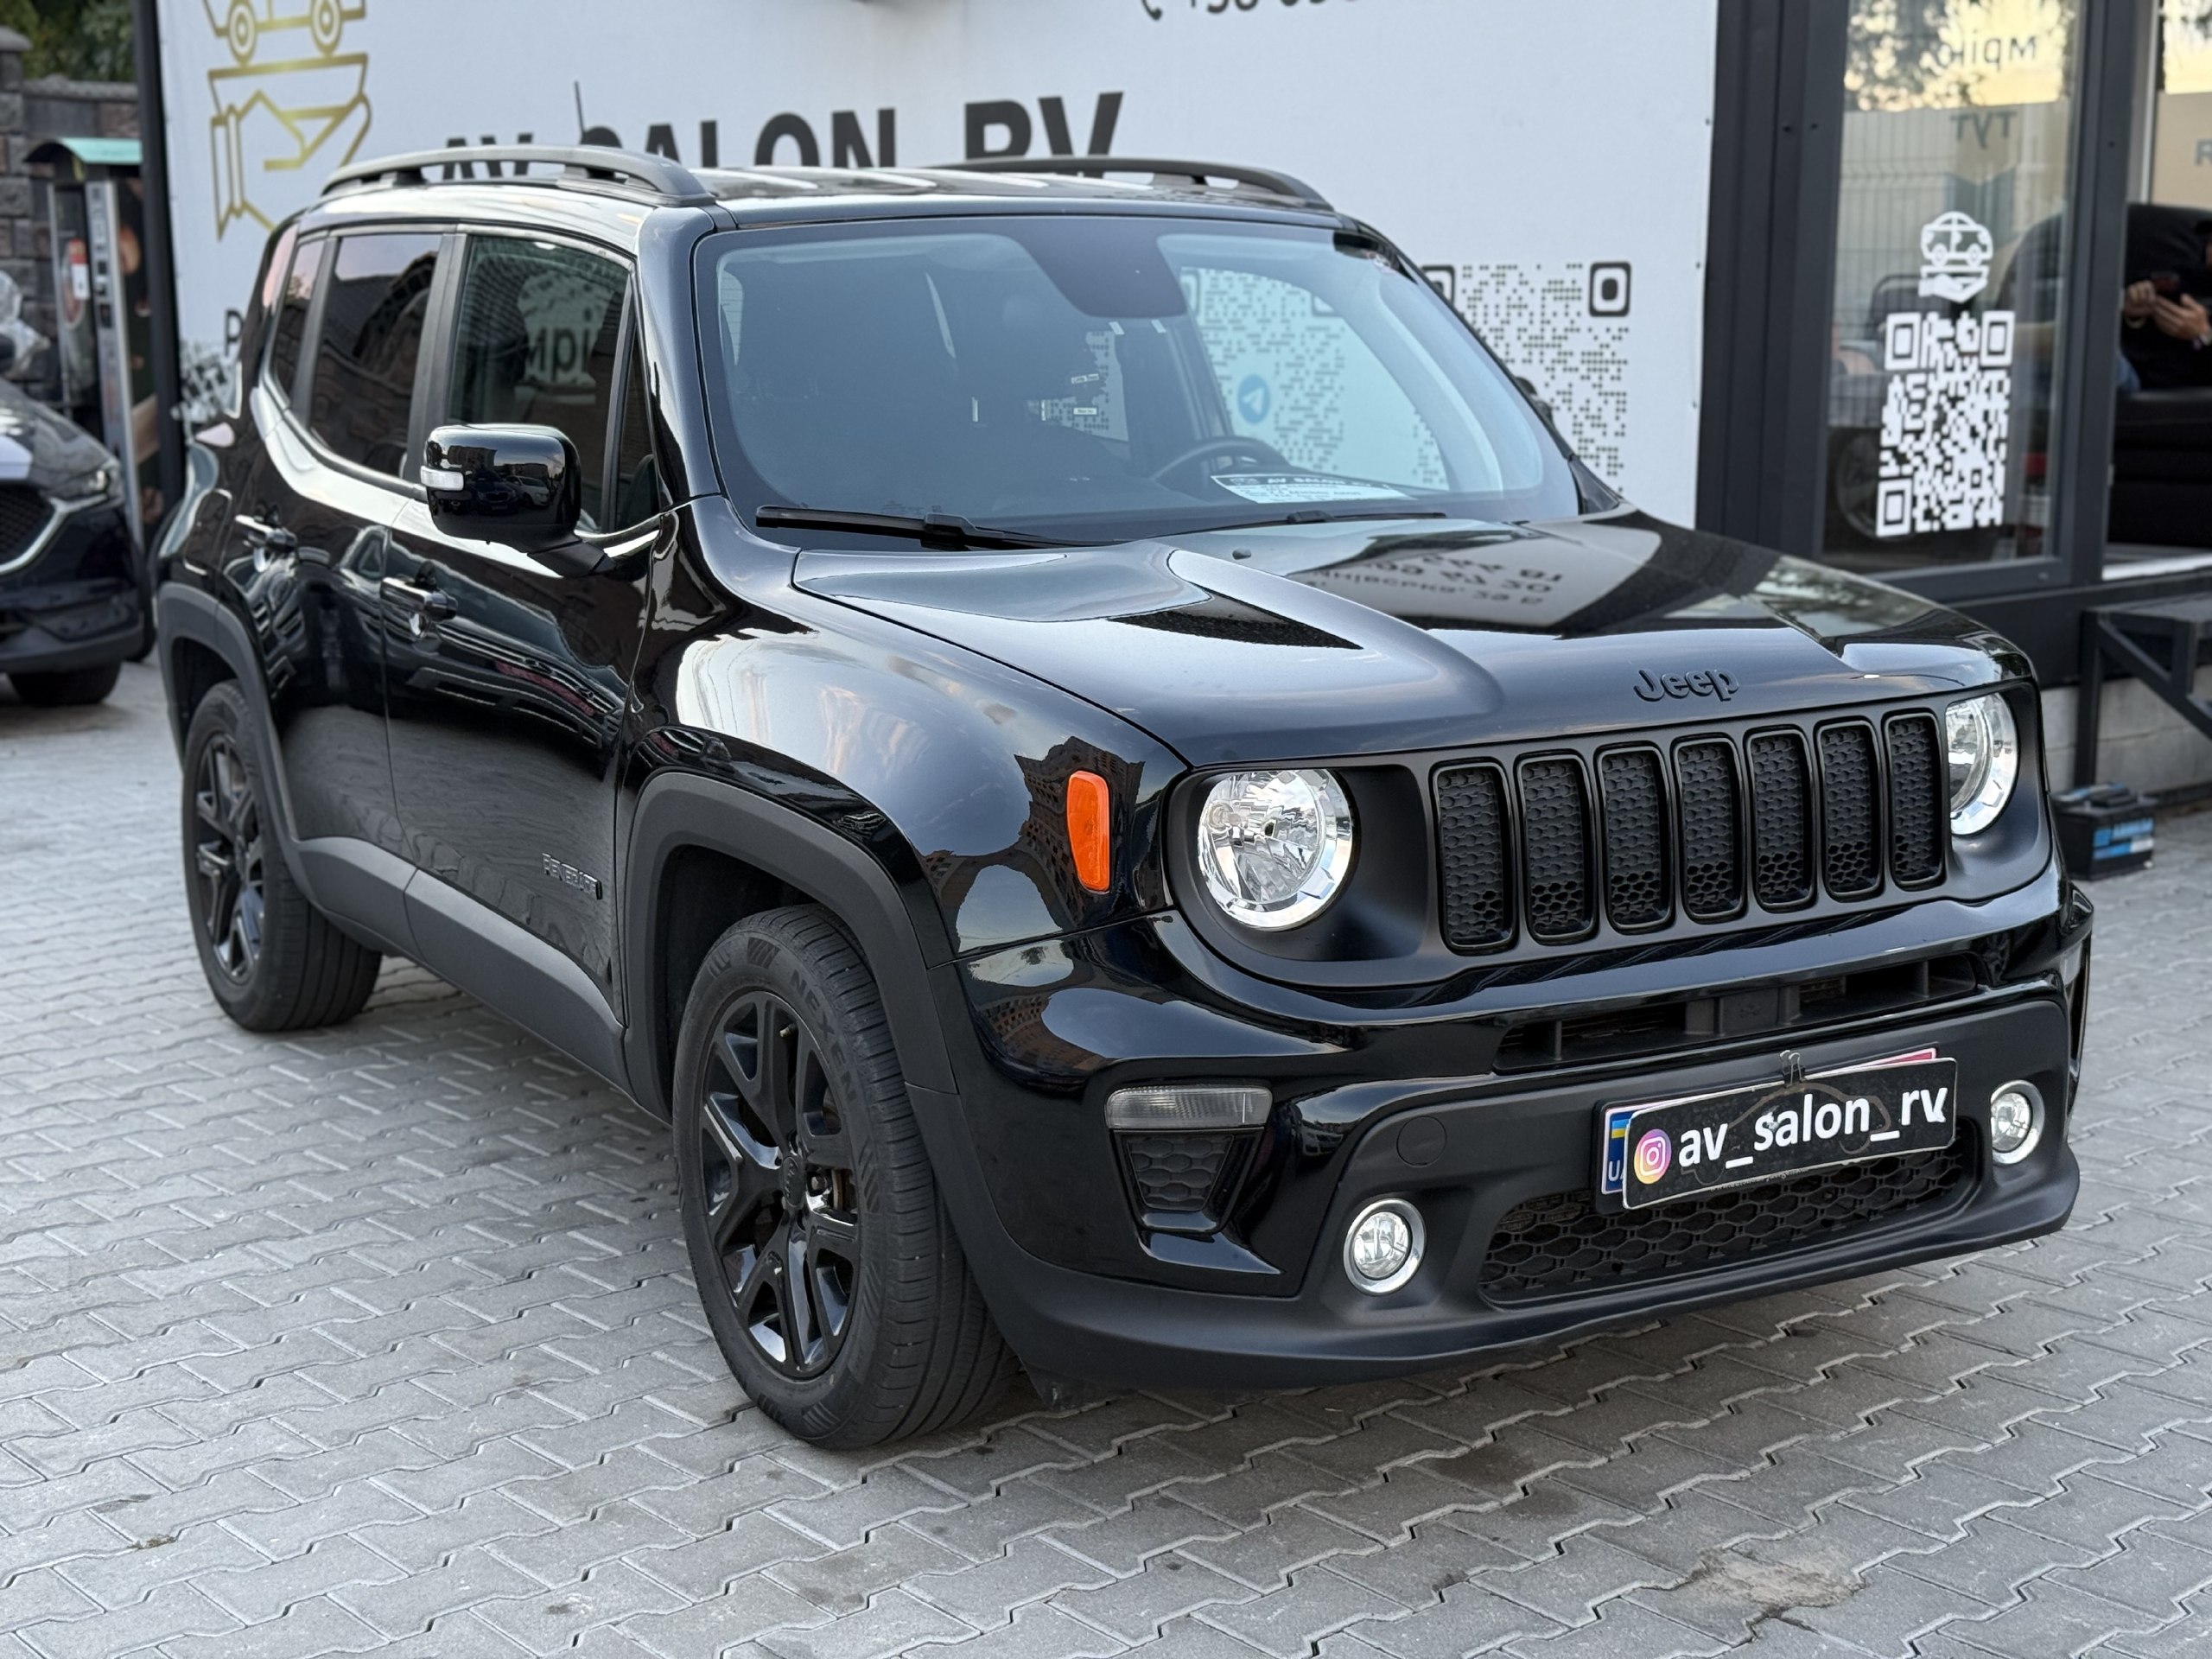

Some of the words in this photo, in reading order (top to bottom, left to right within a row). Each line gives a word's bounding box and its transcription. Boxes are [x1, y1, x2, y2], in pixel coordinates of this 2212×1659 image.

[580, 107, 896, 168] ALON
[1633, 668, 1739, 702] Jeep
[790, 969, 857, 1105] NEXEN
[1678, 1087, 1948, 1169] av_salon_rv
